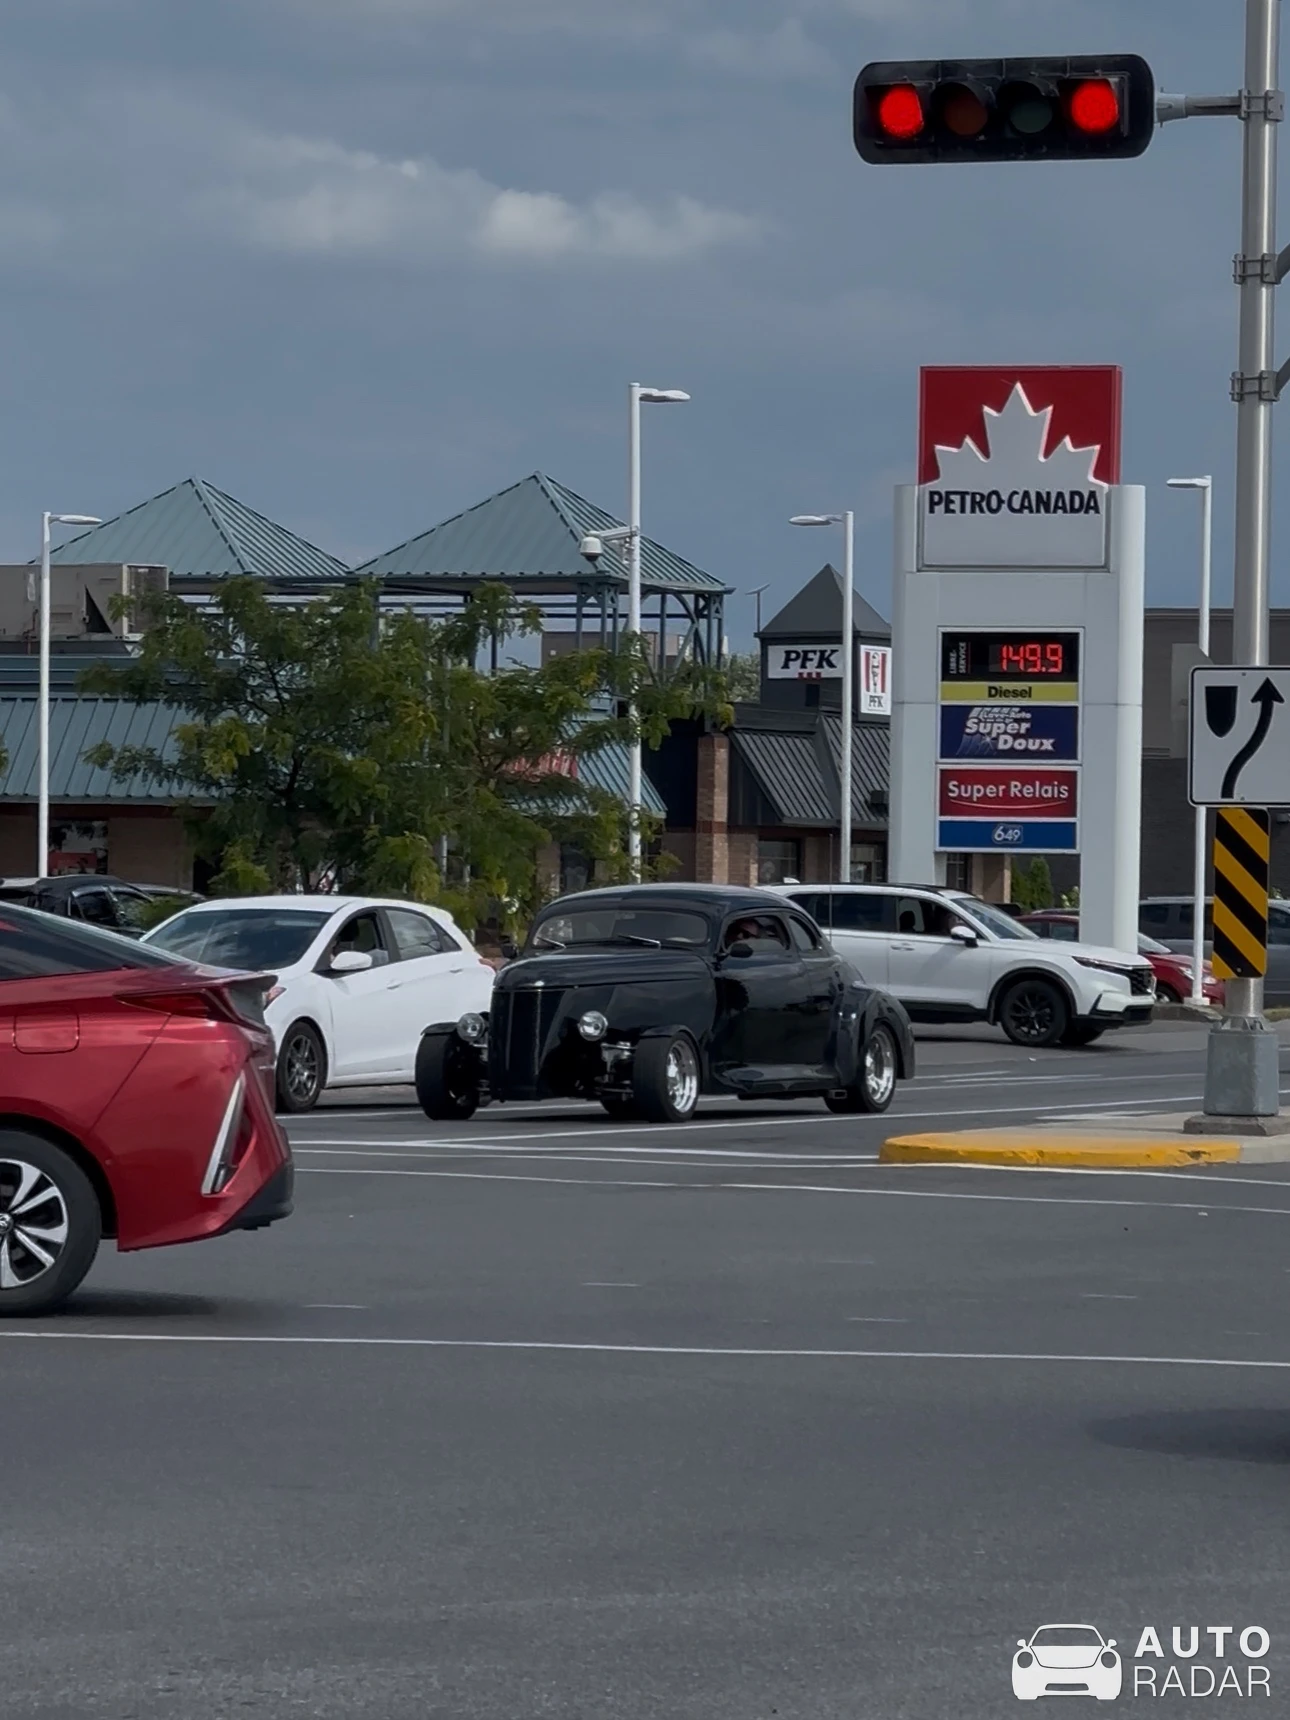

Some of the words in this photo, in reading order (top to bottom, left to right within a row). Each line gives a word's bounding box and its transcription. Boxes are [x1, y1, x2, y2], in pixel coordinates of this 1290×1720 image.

[781, 649, 839, 669] PFK
[958, 642, 967, 674] SERVICE
[1001, 644, 1063, 672] 149.9
[987, 686, 1032, 699] Diesel
[965, 719, 1031, 738] Super
[997, 734, 1056, 751] Doux
[948, 781, 1006, 801] Super
[1010, 781, 1069, 799] Relais
